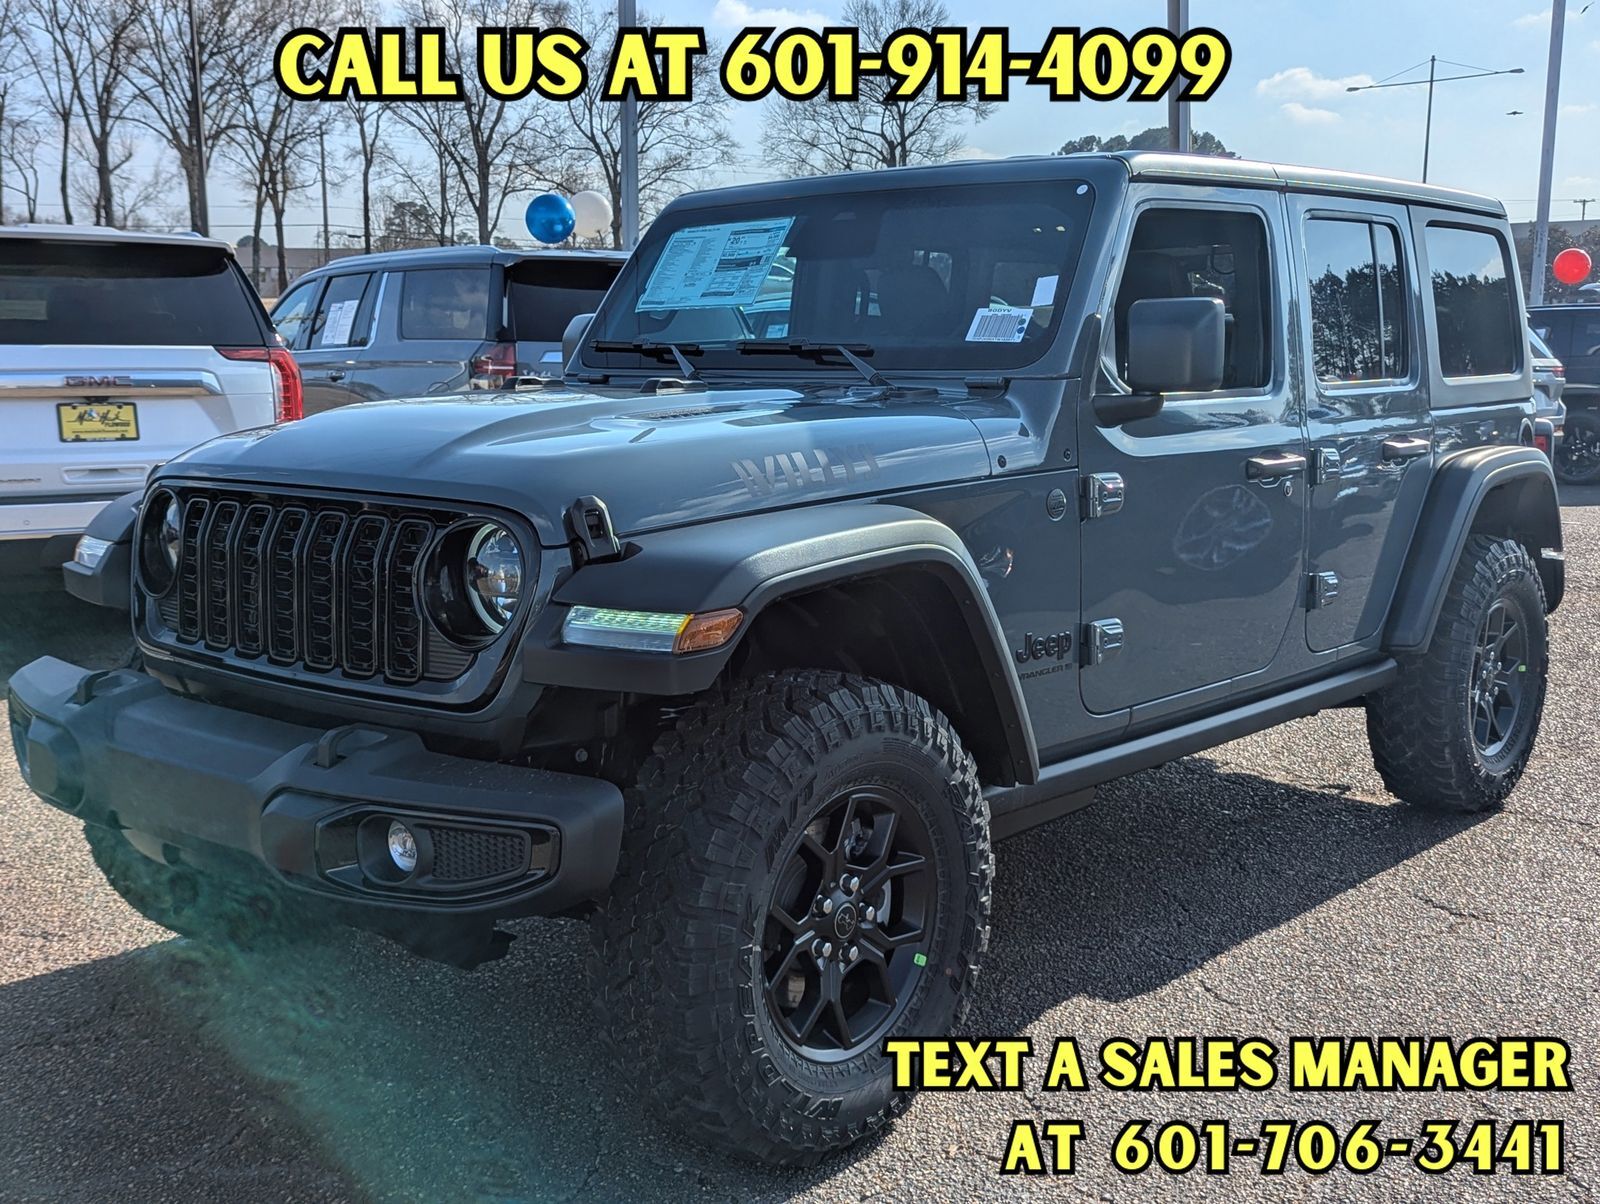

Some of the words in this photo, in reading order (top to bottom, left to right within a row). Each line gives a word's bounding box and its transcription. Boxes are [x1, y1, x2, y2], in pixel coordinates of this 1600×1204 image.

[64, 375, 132, 387] GMC
[1016, 631, 1072, 664] Jeep
[1019, 664, 1063, 681] WRANGLER
